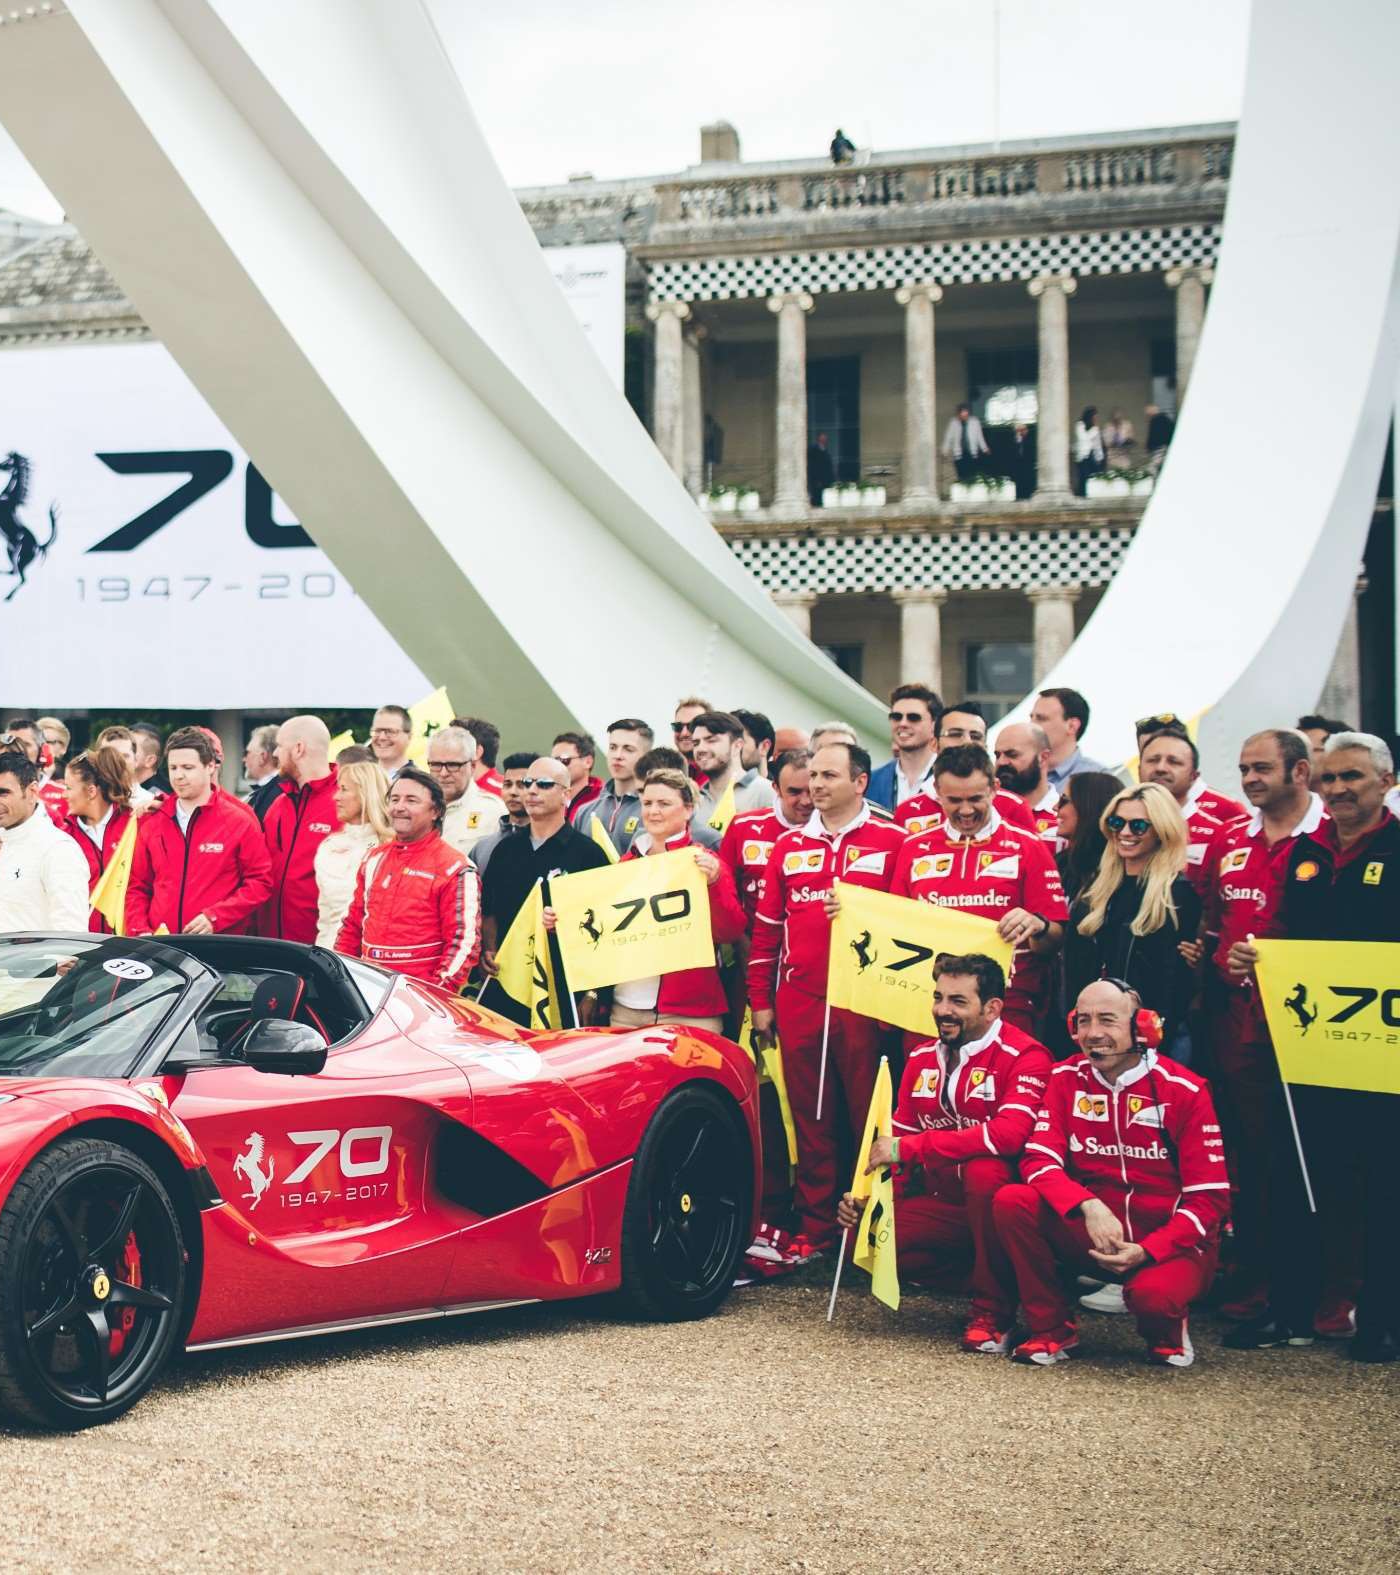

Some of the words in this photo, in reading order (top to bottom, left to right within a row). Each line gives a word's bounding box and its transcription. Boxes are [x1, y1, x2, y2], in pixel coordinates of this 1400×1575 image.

[76, 573, 357, 602] 1947-20
[928, 889, 1011, 907] Santander
[612, 889, 691, 933] 70
[612, 922, 692, 947] 1947-2017
[884, 938, 934, 971] 7
[109, 961, 145, 976] 319
[879, 974, 930, 994] 1947-
[1324, 1030, 1399, 1044] 1947-2
[282, 1126, 393, 1185] 70
[1085, 1136, 1169, 1160] Santande
[280, 1183, 389, 1208] 1947-2017
